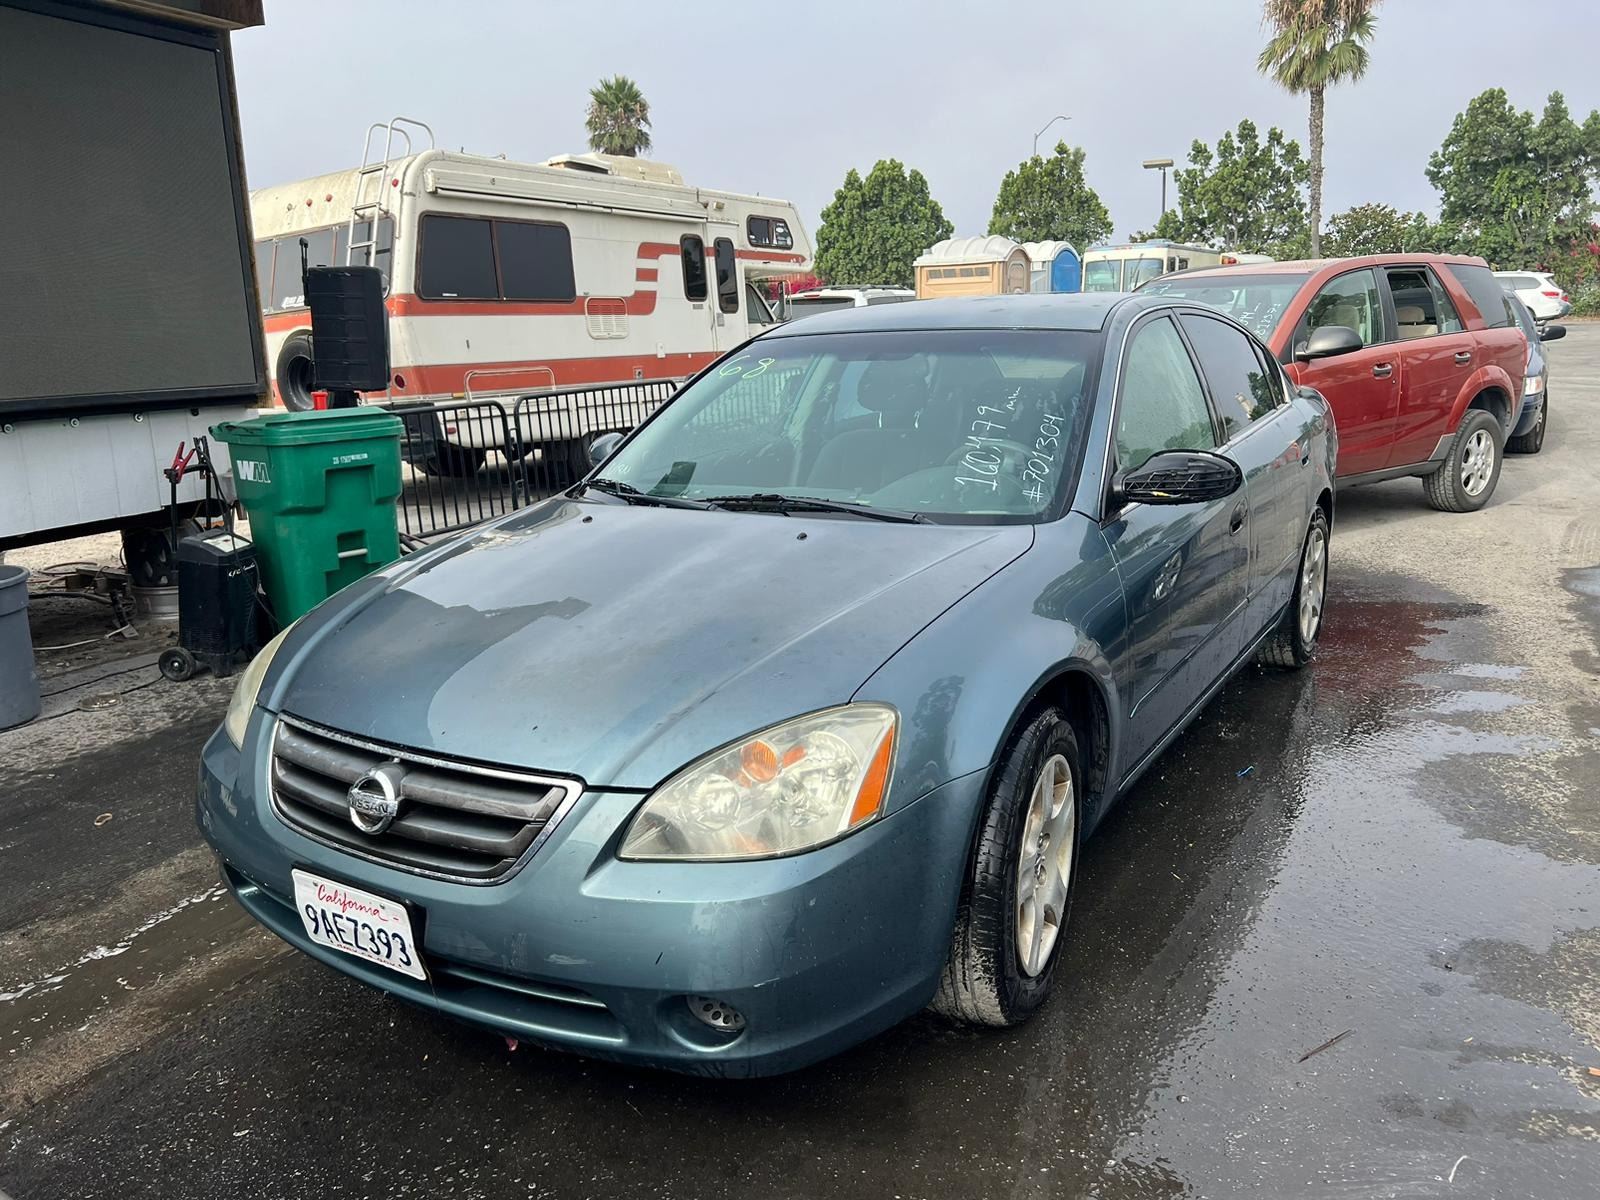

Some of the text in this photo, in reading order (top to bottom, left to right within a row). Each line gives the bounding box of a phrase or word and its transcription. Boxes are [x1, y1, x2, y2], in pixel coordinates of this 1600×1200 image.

[719, 355, 775, 379] 68
[954, 405, 1006, 491] 160,479
[1022, 413, 1064, 502] #701304
[236, 460, 271, 483] WM
[350, 796, 390, 815] NISSAN
[317, 883, 388, 922] California
[305, 904, 412, 966] 9AEZ393
